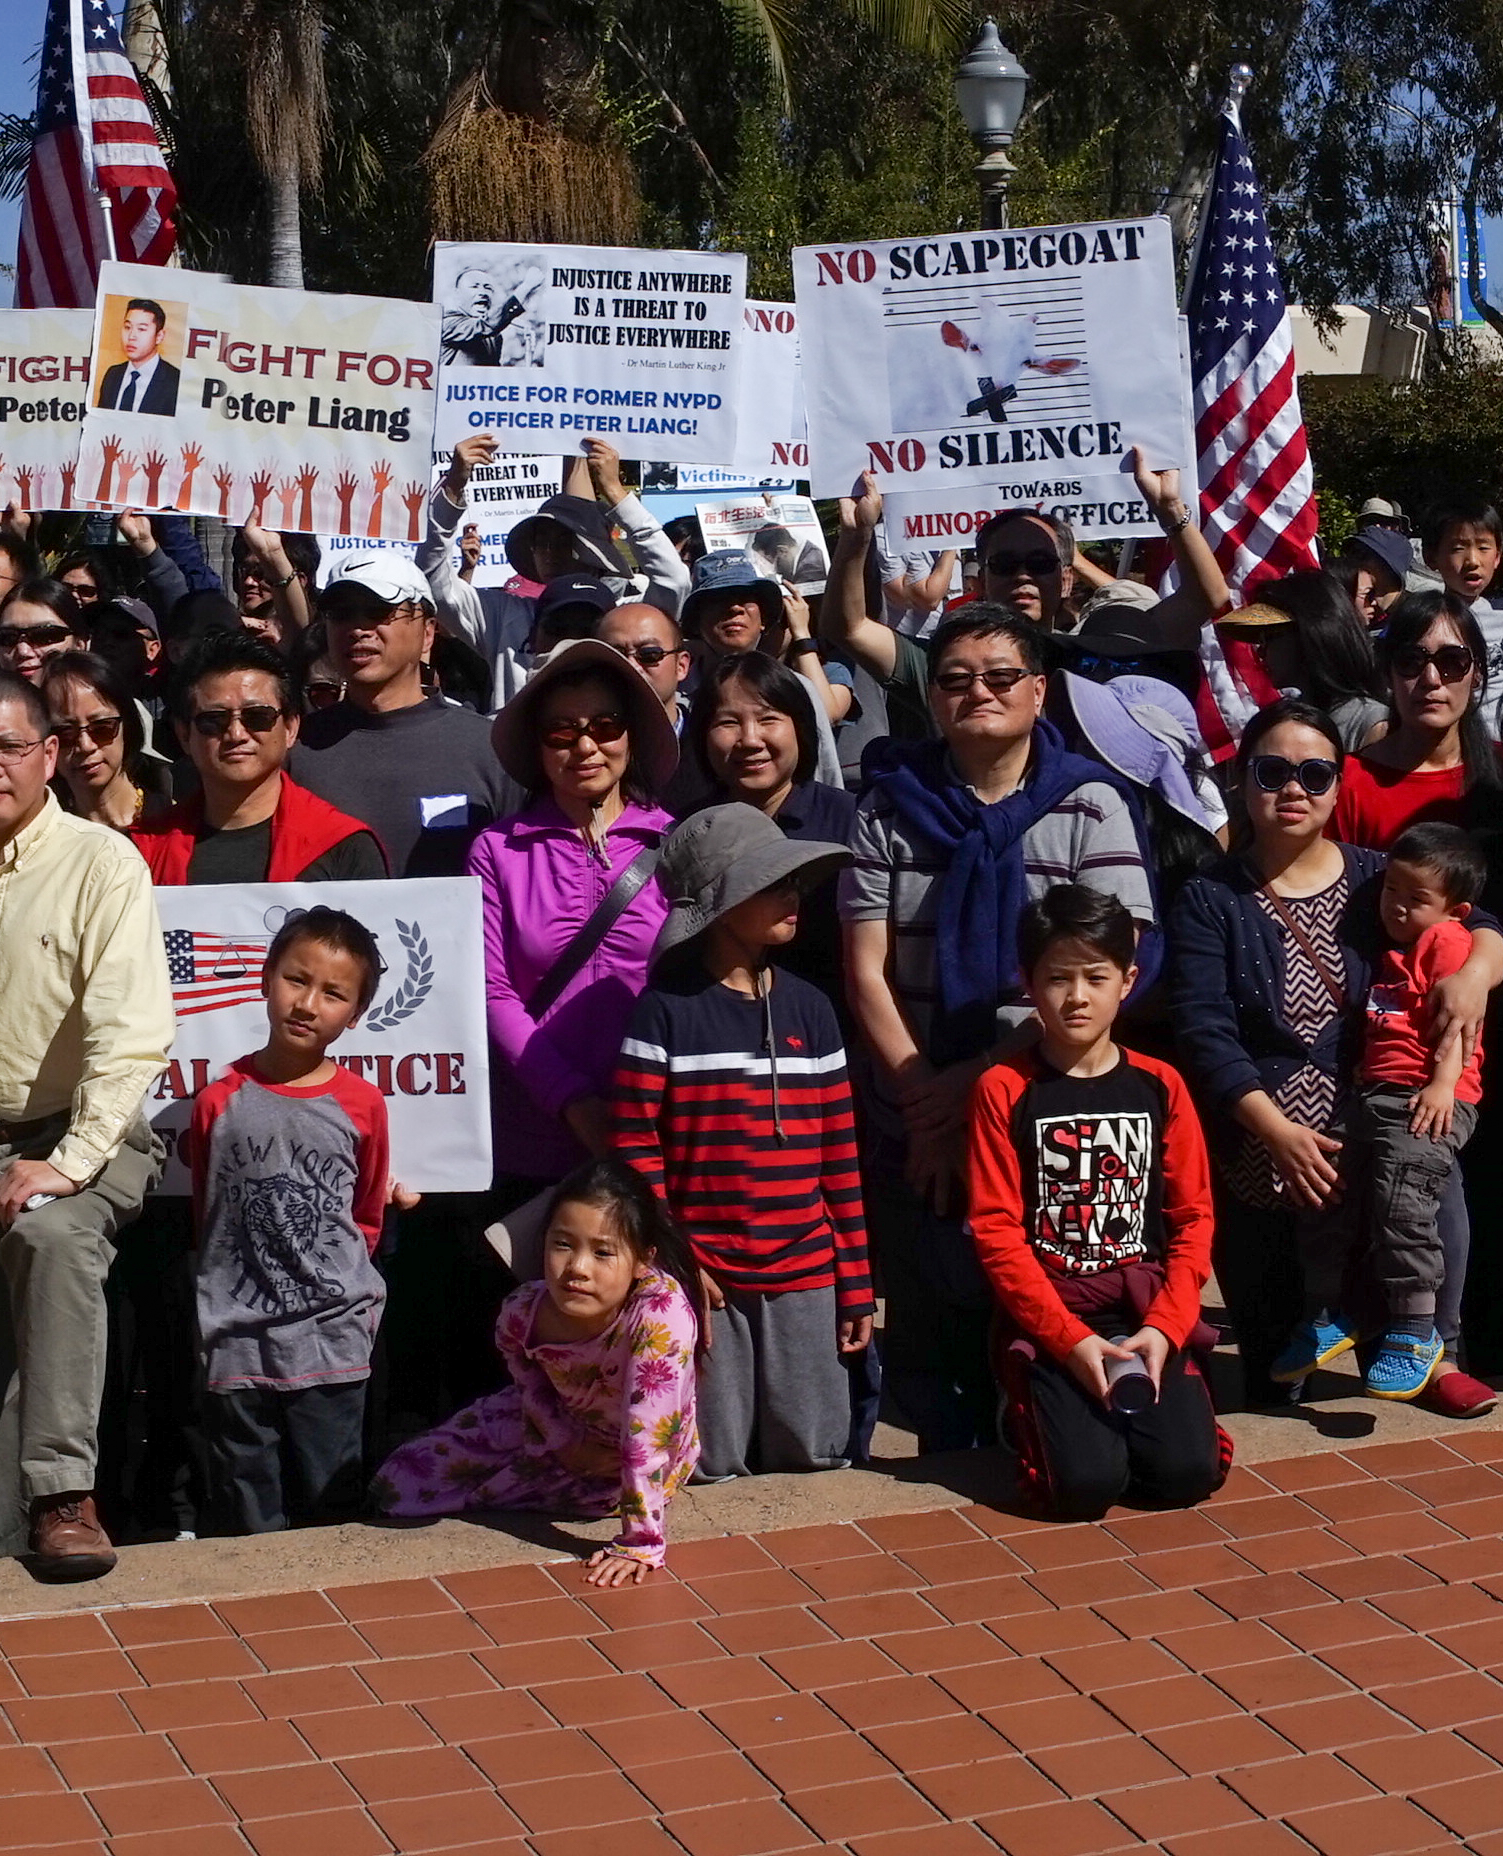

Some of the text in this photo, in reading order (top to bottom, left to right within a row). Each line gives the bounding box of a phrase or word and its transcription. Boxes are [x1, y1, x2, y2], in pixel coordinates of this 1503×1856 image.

[816, 226, 1145, 286] NO SCAPEGOAT
[552, 268, 732, 294] INJUSTICE ANYWHERE
[574, 297, 707, 321] IS A THREAT TO
[548, 324, 731, 350] JUSTICE EVERYWHERE
[186, 328, 434, 390] FIGHT FOR
[627, 359, 717, 372] Dr Martin Luther King
[201, 377, 411, 442] Peter Liang
[446, 385, 722, 410] JUSTICE FOR FORMER NYPD
[468, 411, 698, 435] OFFICER PETER LIANG!
[866, 422, 1123, 475] NO SILENCE
[522, 464, 539, 477] TO
[473, 482, 559, 503] EVERYWHERE
[330, 538, 386, 550] JUSTICE
[217, 1136, 347, 1193] NEW YORK
